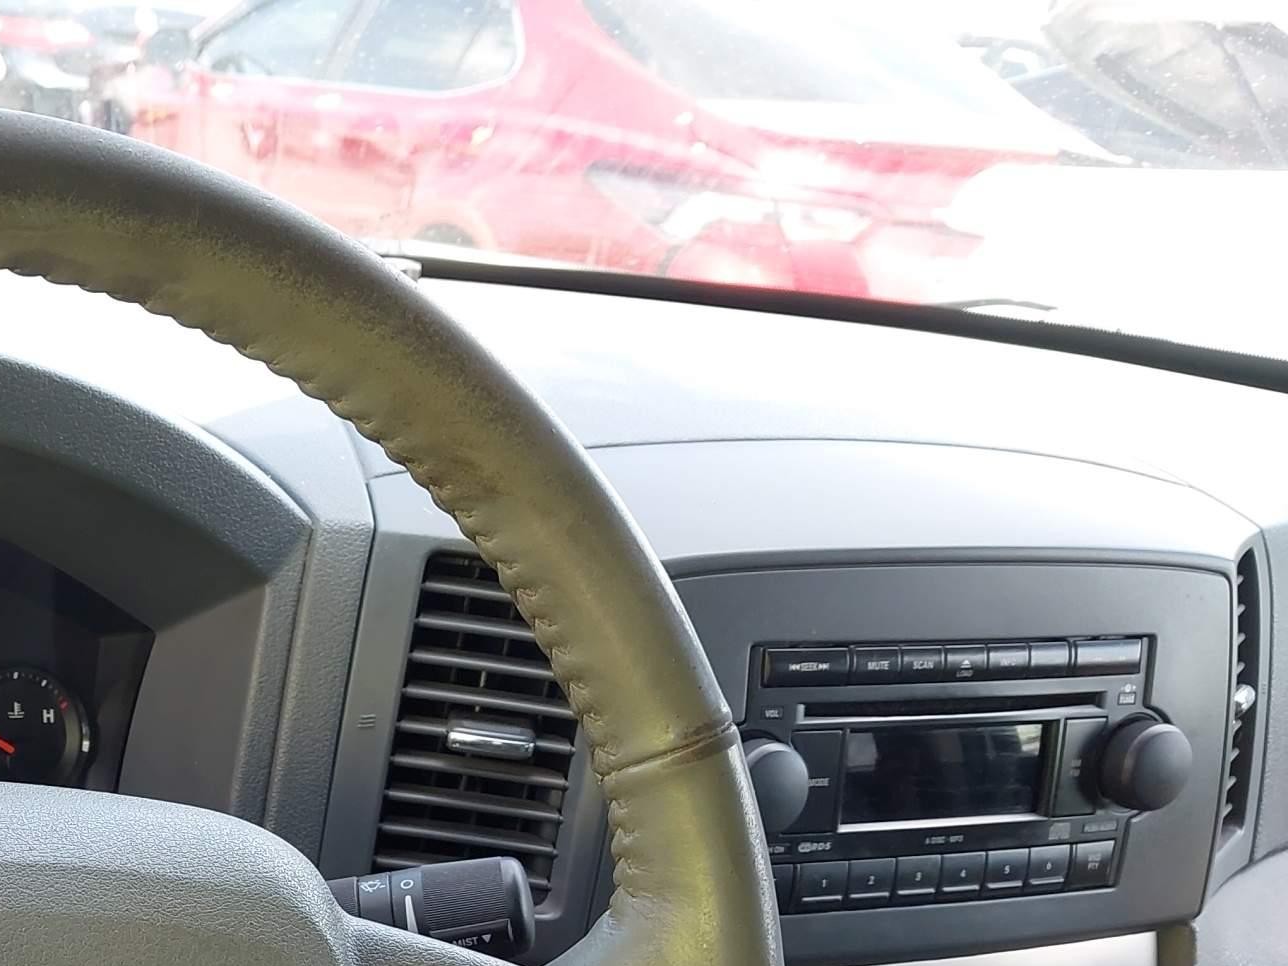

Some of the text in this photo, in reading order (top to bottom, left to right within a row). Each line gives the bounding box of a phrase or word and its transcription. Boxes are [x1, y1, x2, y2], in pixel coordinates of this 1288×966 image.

[867, 660, 890, 670] MUTE
[913, 660, 934, 670] SCAN
[42, 709, 54, 723] H
[1003, 865, 1010, 874] 5
[867, 876, 875, 885] 2
